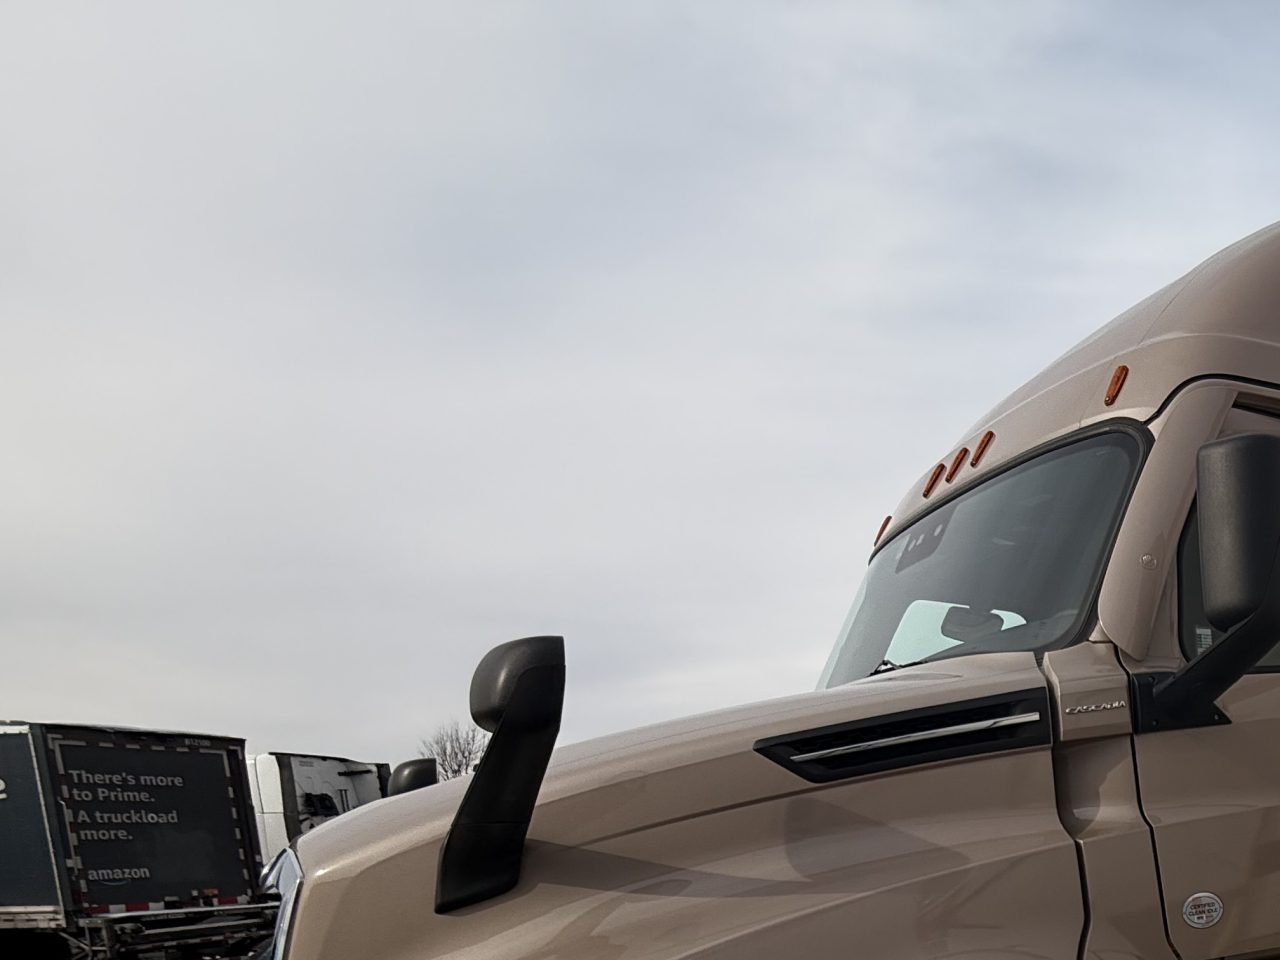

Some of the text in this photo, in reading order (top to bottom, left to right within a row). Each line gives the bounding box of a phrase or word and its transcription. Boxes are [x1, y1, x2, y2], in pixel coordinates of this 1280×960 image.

[1065, 700, 1126, 714] CASCADIA
[68, 769, 184, 786] There's more
[72, 787, 155, 802] to Prime.
[77, 809, 178, 823] A truckload
[79, 829, 133, 840] more.
[88, 867, 150, 880] amazon
[1190, 902, 1215, 910] CERTIFIED
